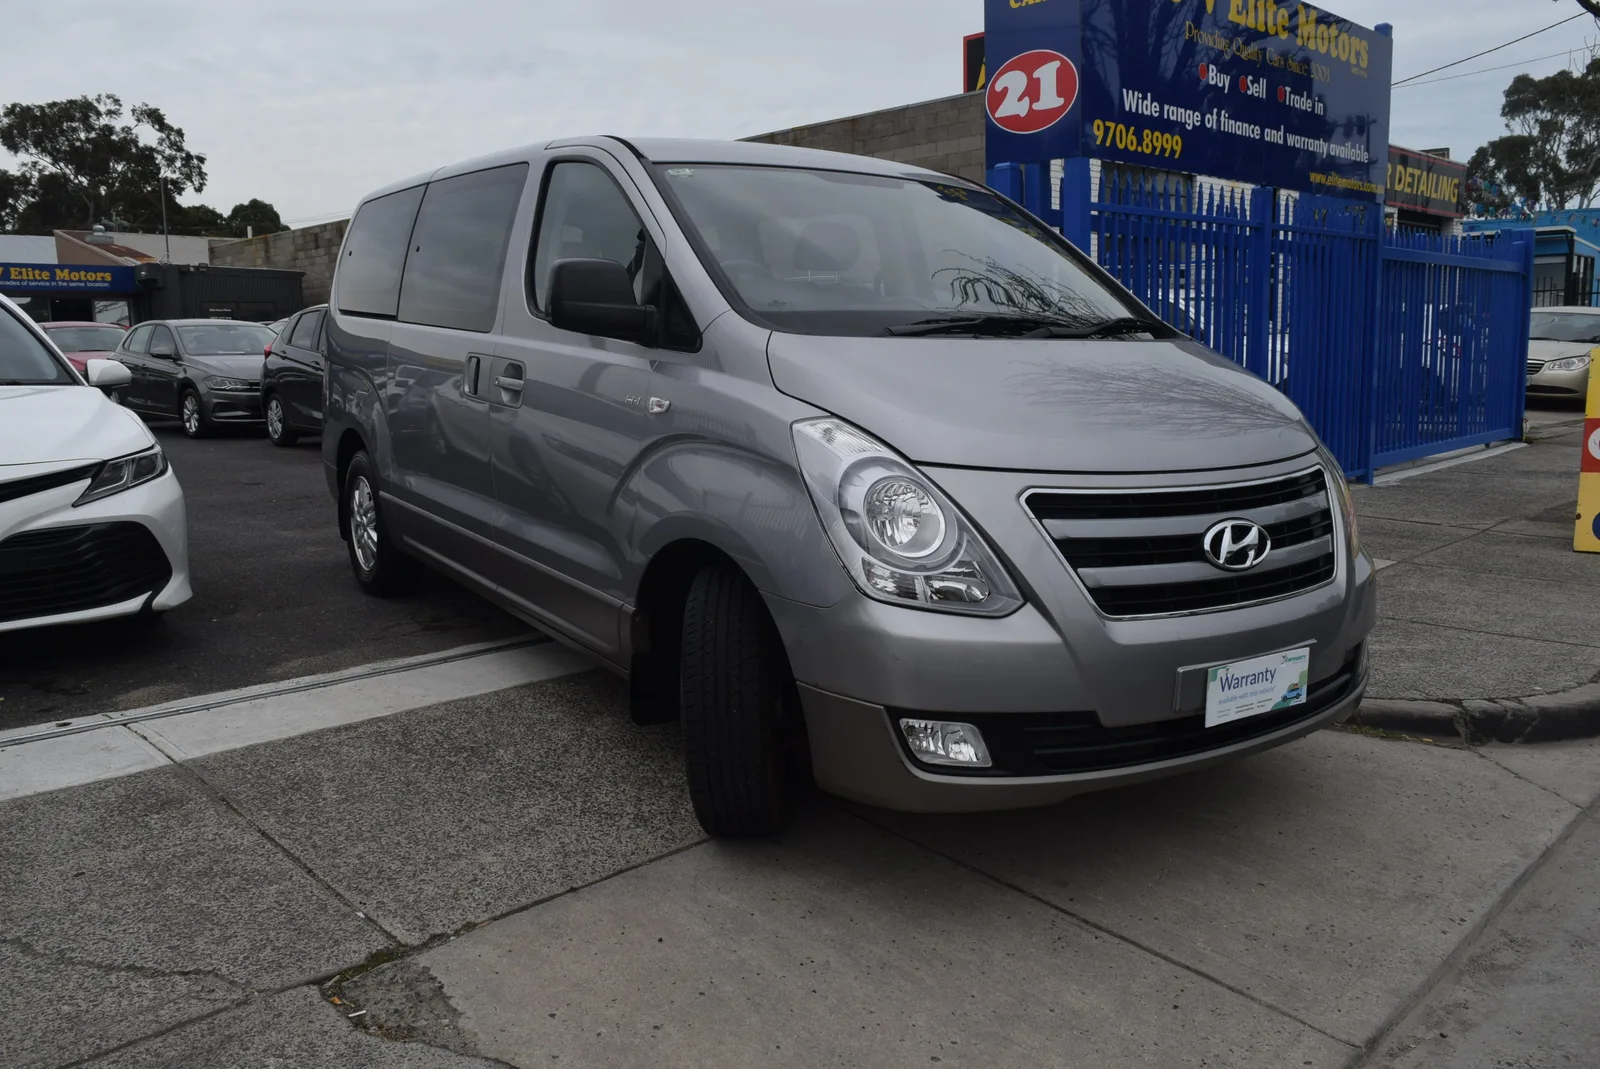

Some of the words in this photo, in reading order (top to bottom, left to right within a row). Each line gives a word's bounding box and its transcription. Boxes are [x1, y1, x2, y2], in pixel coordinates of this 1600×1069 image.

[1185, 20, 1230, 59] Providing
[1233, 37, 1262, 68] Quality
[1266, 47, 1285, 69] Cars
[1287, 54, 1308, 77] Since
[1296, 4, 1369, 68] Motors
[994, 60, 1065, 118] 21
[1208, 63, 1231, 94] Buy
[1247, 75, 1267, 99] Sell
[1285, 86, 1312, 112] Trade
[1315, 97, 1324, 116] in
[1093, 119, 1183, 159] 9706.8999
[1122, 88, 1160, 117] Wide
[1164, 104, 1201, 130] range
[1205, 108, 1218, 129] of
[1220, 110, 1261, 139] finance
[1264, 125, 1285, 144] and
[1287, 132, 1329, 158] warranty
[1330, 141, 1369, 163] available
[1395, 163, 1460, 203] DETAILING
[9, 267, 51, 280] Elite
[55, 268, 112, 281] Motors
[1220, 666, 1277, 693] Warranty
